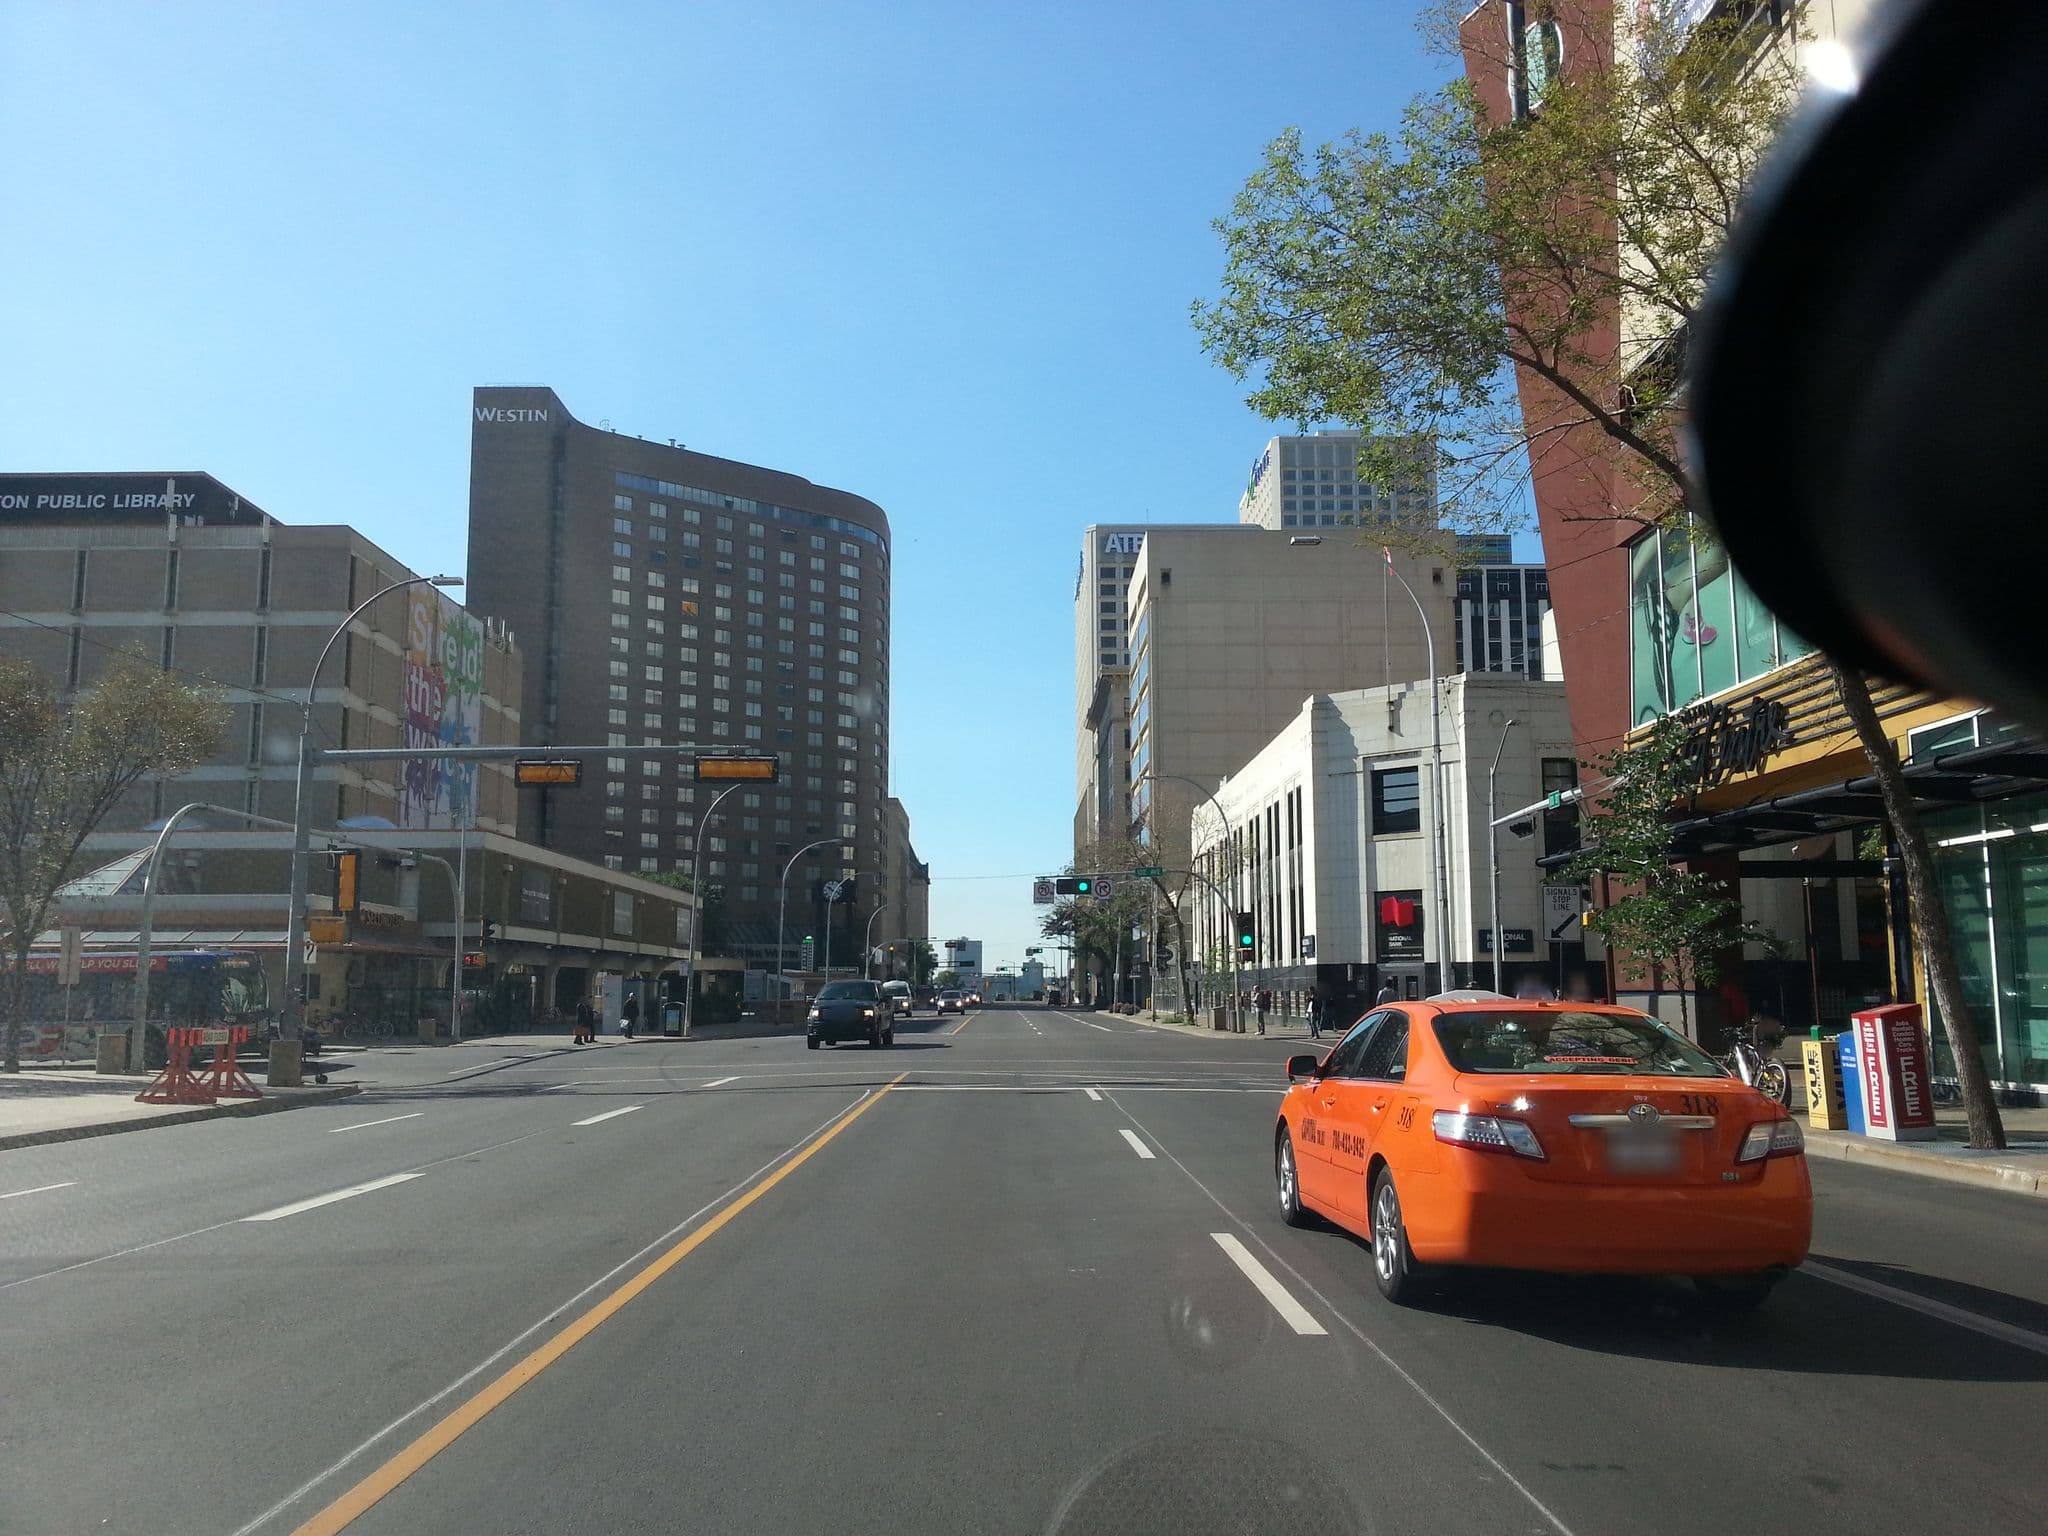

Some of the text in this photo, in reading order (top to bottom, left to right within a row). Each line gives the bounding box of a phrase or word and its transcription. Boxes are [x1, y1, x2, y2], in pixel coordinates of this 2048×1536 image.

[474, 407, 548, 422] WESTIN
[36, 494, 106, 509] PUBLIC
[113, 493, 196, 509] LIBRARY
[410, 667, 442, 720] the
[1545, 887, 1578, 896] SIGNALS
[1552, 896, 1571, 904] STOP
[1486, 933, 1527, 941] NONAL
[1486, 941, 1510, 949] BK
[98, 958, 120, 969] YOU
[122, 958, 157, 968] SLP
[1607, 1056, 1639, 1065] DEBIT
[1807, 1049, 1819, 1109] VUE
[1867, 1056, 1882, 1116] FREE
[1900, 1055, 1922, 1117] FREE
[1679, 1093, 1720, 1116] 318
[1397, 1106, 1416, 1129] 318
